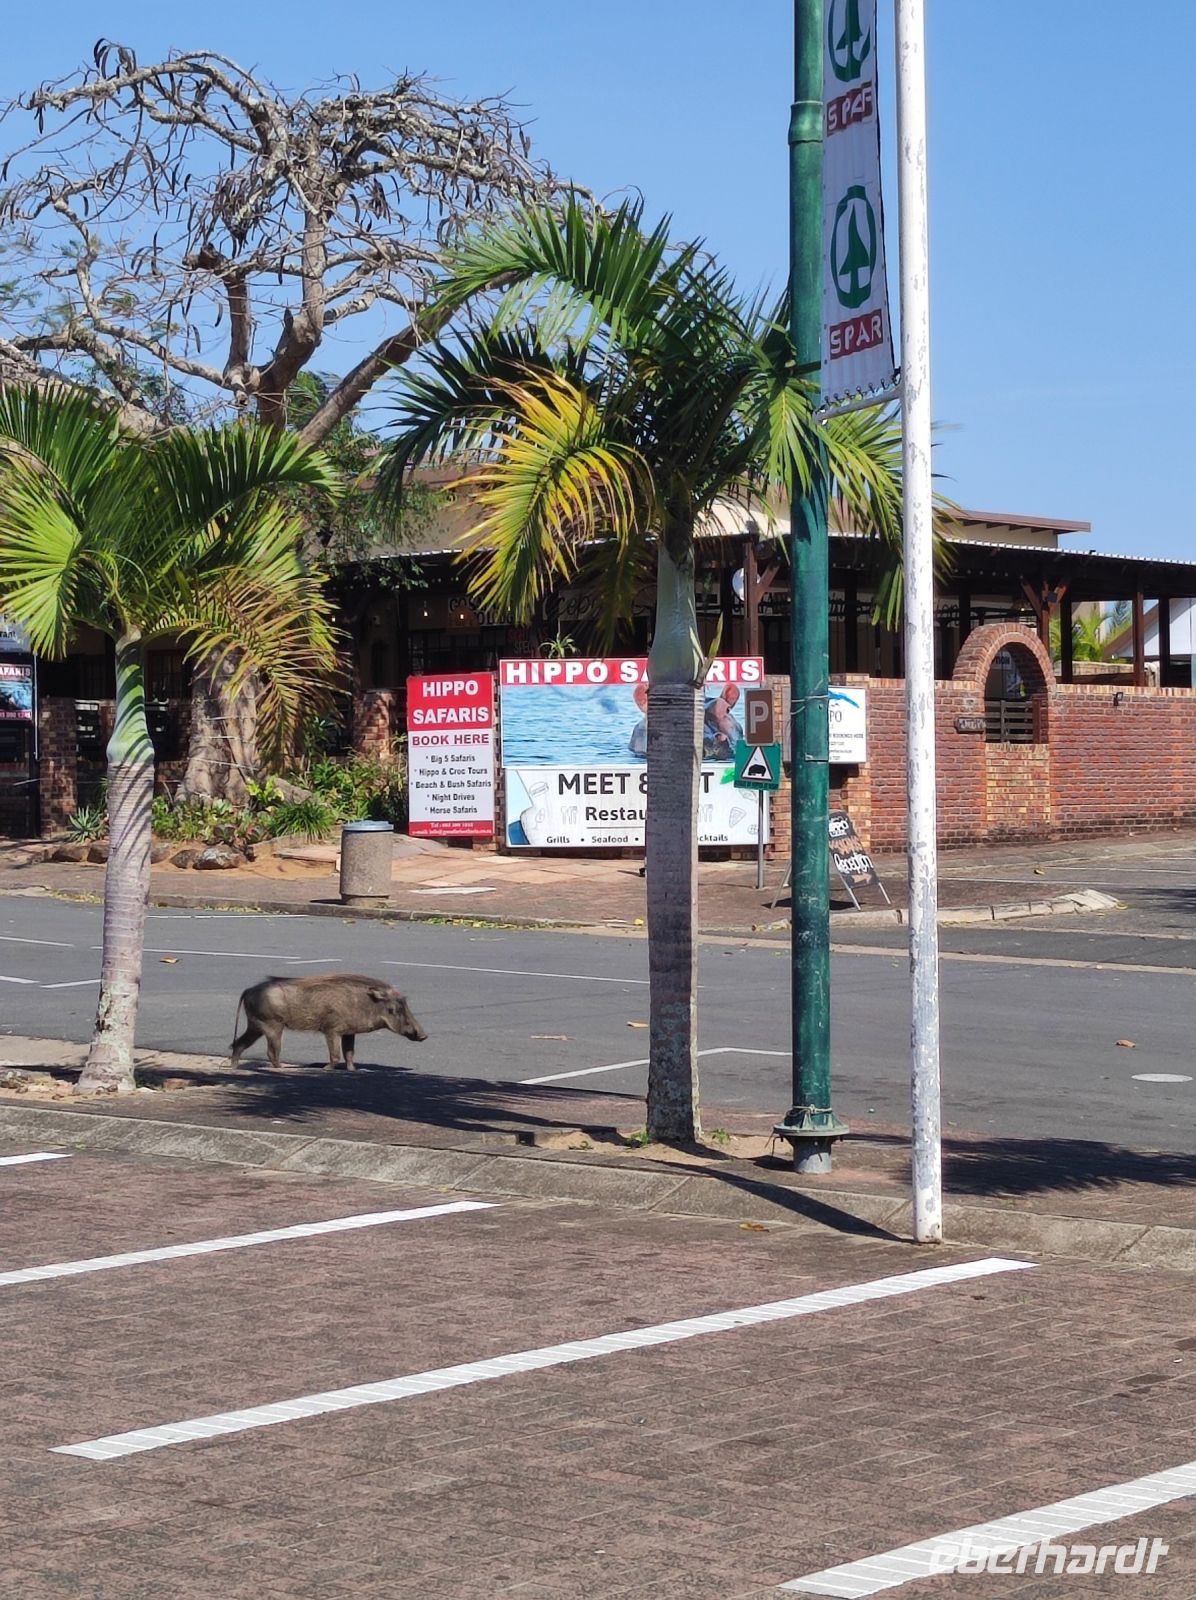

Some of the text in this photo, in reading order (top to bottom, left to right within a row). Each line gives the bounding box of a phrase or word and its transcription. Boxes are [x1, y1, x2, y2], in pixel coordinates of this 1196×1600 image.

[830, 319, 882, 354] SPAR
[506, 661, 609, 684] HIPPO
[422, 680, 479, 697] HIPPO
[413, 706, 489, 724] SAFARIS
[749, 700, 769, 734] P
[412, 734, 489, 746] BOOK HERE
[431, 755, 442, 764] Big
[451, 754, 475, 762] Safaris
[419, 768, 439, 777] Hippo
[468, 767, 488, 775] Tours
[467, 780, 492, 788] Safaris
[558, 773, 630, 795] MEET
[432, 794, 451, 802] Night
[453, 806, 478, 814] Safaris
[585, 806, 647, 821] Restau
[546, 833, 729, 844] Grills Seafood cktails
